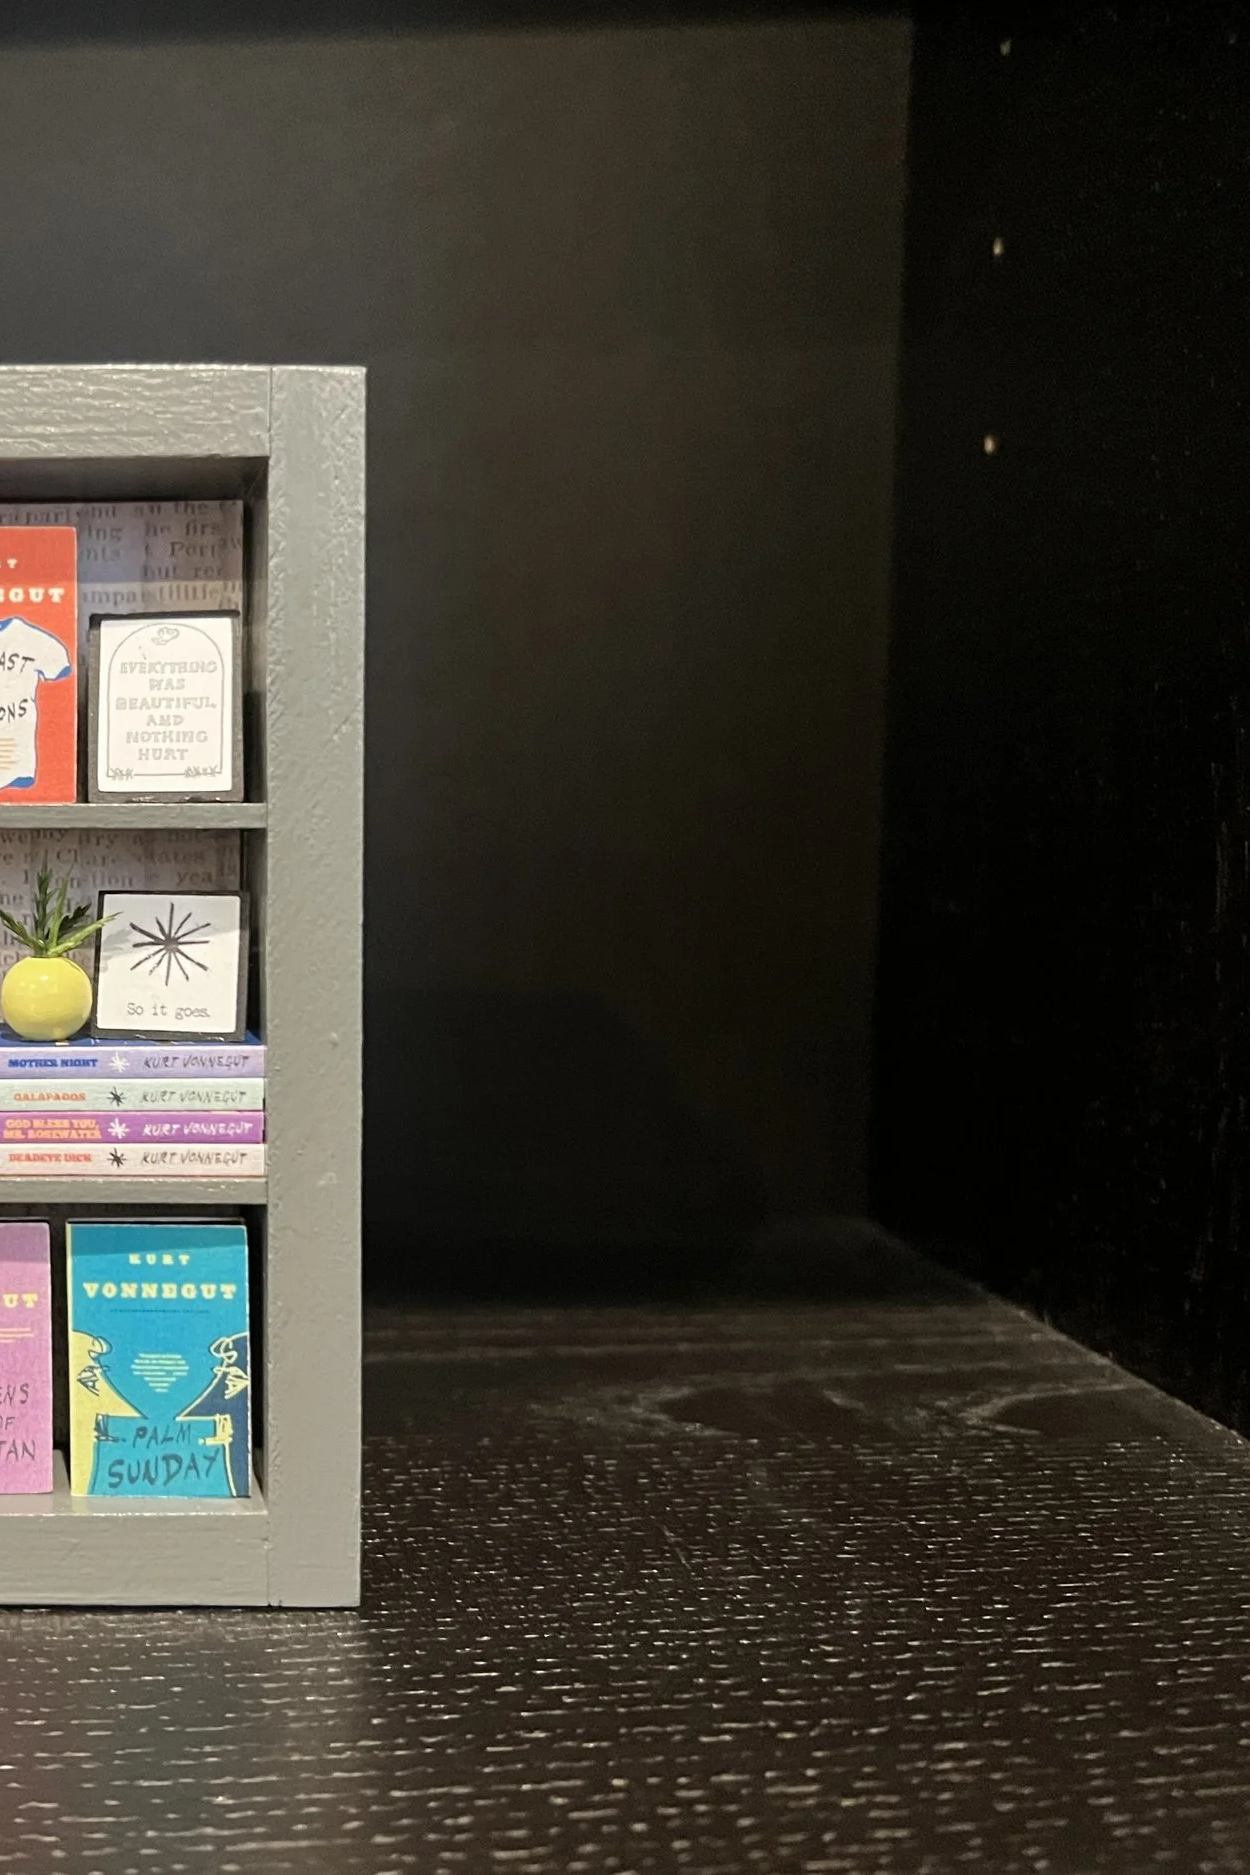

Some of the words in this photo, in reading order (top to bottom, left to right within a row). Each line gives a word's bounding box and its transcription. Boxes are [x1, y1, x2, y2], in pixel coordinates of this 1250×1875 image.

[119, 660, 218, 674] EVERYTHING
[149, 678, 186, 691] WAS
[146, 714, 184, 727] AND
[126, 730, 209, 744] NOTHING
[138, 747, 189, 761] HURT
[127, 1002, 144, 1016] So
[152, 1003, 167, 1016] it
[8, 1058, 58, 1068] MOTHER
[60, 1058, 98, 1068] NIGHT
[143, 1055, 179, 1069] KURT
[183, 1054, 249, 1069] VONNEGUT
[141, 1089, 177, 1104] KURT
[180, 1089, 246, 1104] VONNEGUT
[142, 1123, 180, 1137] KURT
[183, 1122, 254, 1137] VONNEGUT
[9, 1152, 61, 1163] DEADEYE
[64, 1152, 92, 1163] DICK
[141, 1151, 178, 1165] KURT
[180, 1149, 248, 1165] VONNEGUT
[128, 1253, 191, 1266] KURT
[82, 1282, 238, 1300] VONNEGUT
[132, 1424, 193, 1449] PALM
[108, 1446, 220, 1490] SUNDAY
